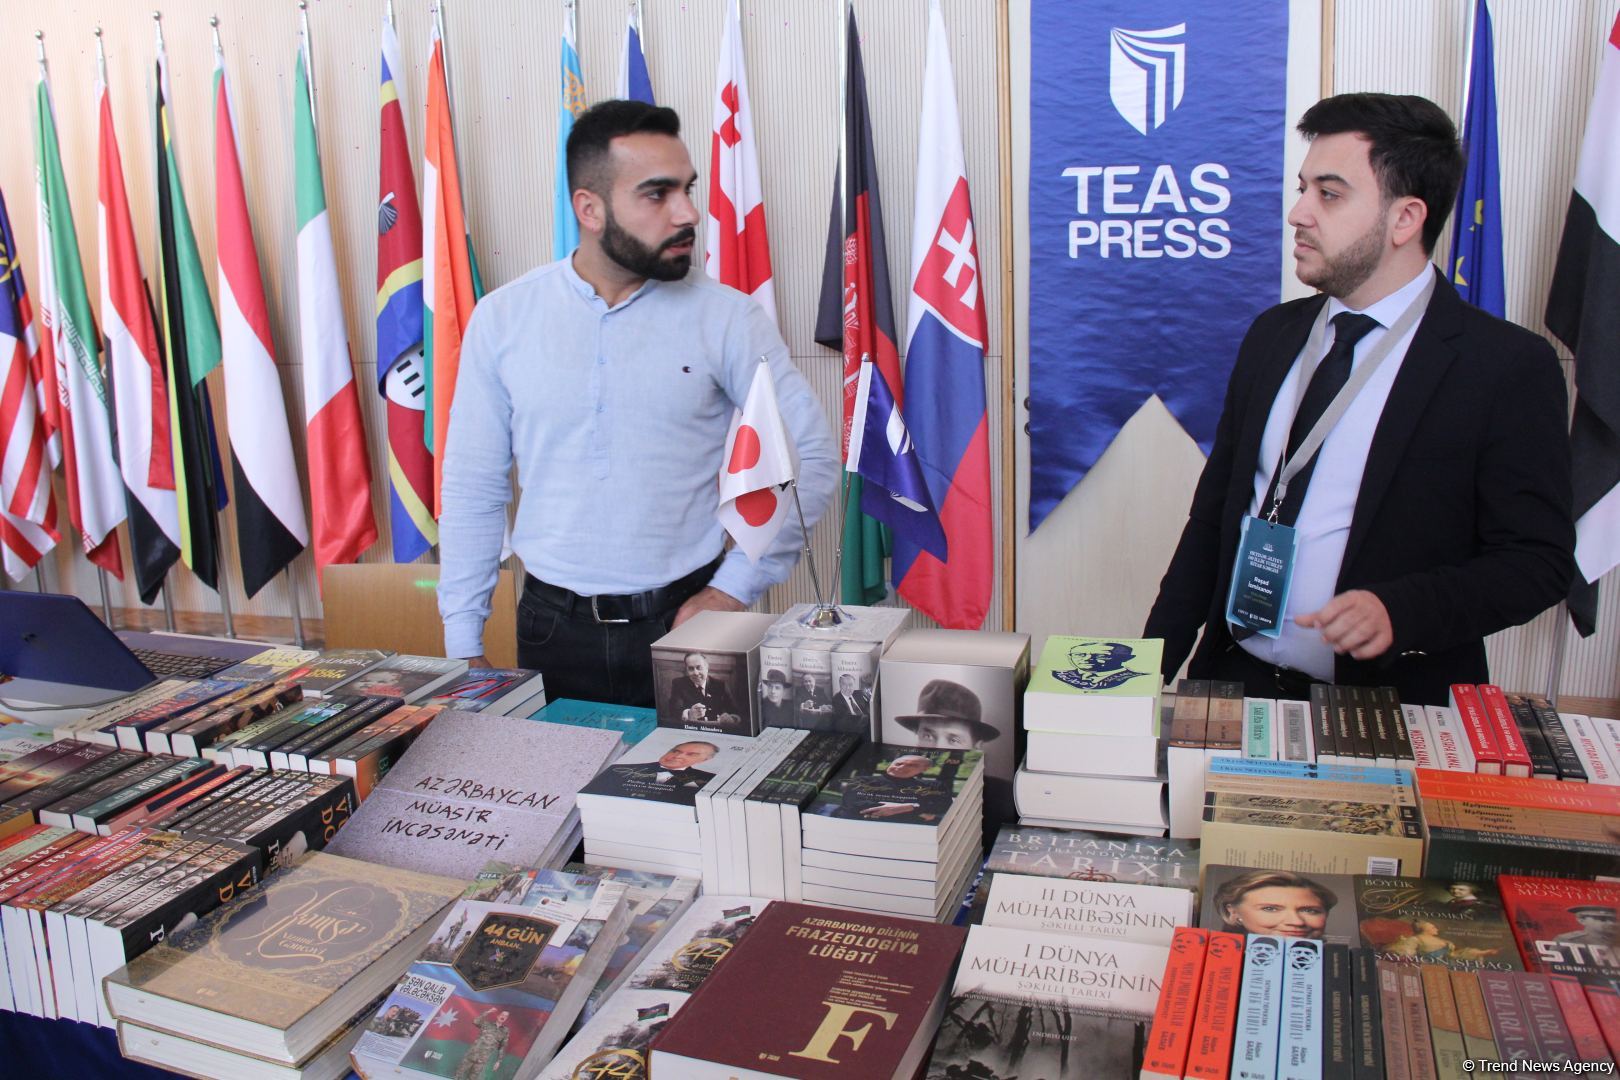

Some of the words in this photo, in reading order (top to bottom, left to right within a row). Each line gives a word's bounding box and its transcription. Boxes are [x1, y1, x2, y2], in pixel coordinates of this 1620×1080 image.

[1062, 163, 1231, 214] TEAS
[1069, 218, 1231, 258] PRESS
[416, 775, 559, 810] AZƏRBAYCAN
[405, 799, 493, 823] MÜASİR
[381, 818, 509, 850] İNCƏSƏNƏTİ
[1008, 833, 1186, 858] BRİTANİYA
[1001, 850, 1182, 881] TARİXİ
[1063, 888, 1137, 909] DÜNYA
[802, 916, 874, 935] AZƏRBAYCAN
[876, 926, 920, 941] DİLİNİN
[997, 900, 1176, 929] MÜHARİBƏSİNİN
[484, 923, 507, 937] 44
[507, 926, 545, 945] GÜN
[786, 925, 921, 956] FRAZEOLOGİYA
[809, 943, 878, 965] LÜĞƏTİ
[1024, 943, 1031, 958] I
[1040, 944, 1119, 969] DÜNYA
[408, 976, 426, 989] SƏN
[423, 981, 447, 996] QALİB
[970, 956, 1162, 993] MÜHARİBƏSİNİN
[788, 1000, 899, 1065] F
